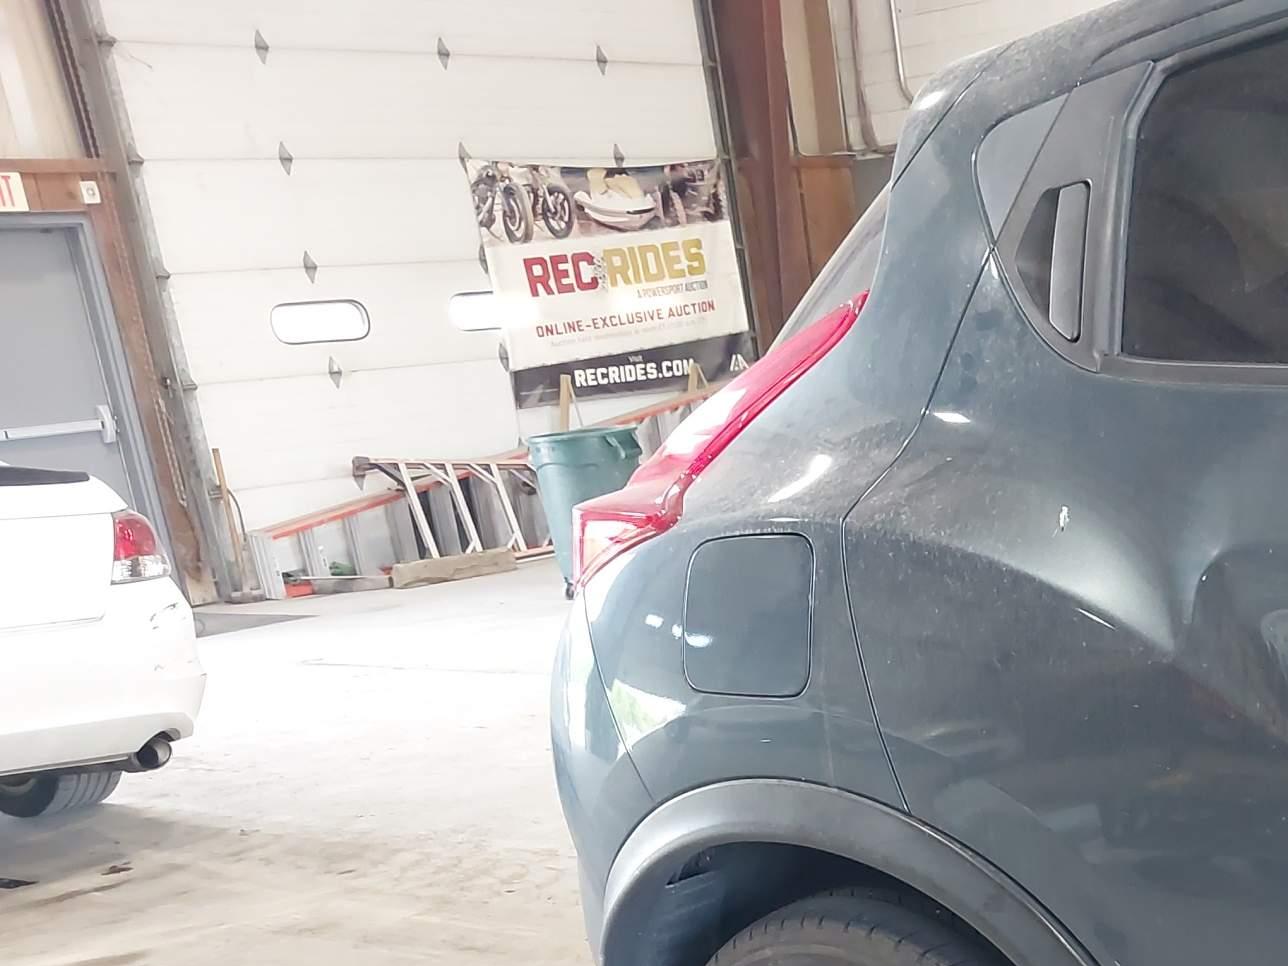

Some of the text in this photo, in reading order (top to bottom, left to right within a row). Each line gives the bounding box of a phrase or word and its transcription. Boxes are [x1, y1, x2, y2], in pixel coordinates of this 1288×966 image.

[523, 238, 706, 297] REC RIDES
[536, 308, 664, 338] ONLINE-EXCLUSIVE
[668, 299, 716, 318] AUCTION
